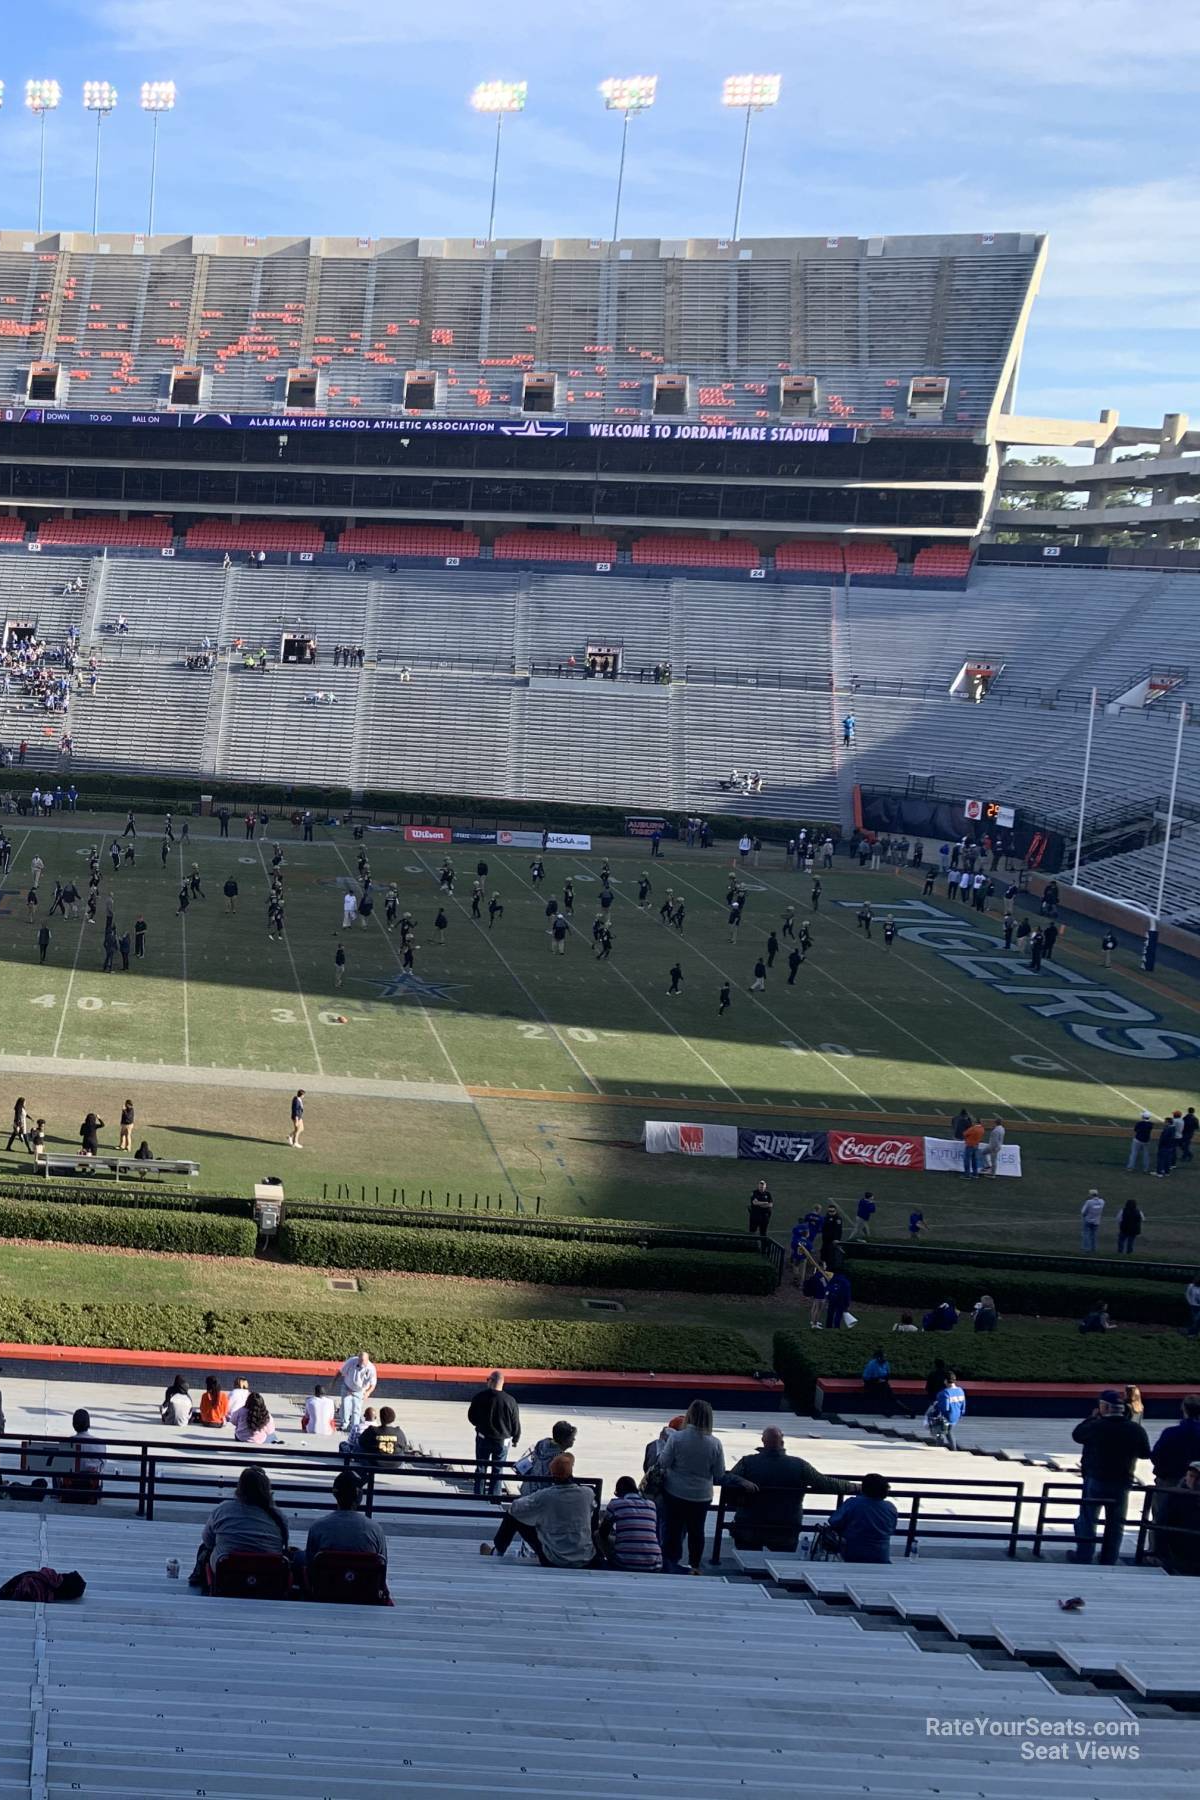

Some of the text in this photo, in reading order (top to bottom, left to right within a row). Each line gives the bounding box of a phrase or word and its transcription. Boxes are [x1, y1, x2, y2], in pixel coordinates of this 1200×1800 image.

[46, 413, 70, 421] DOWN
[90, 414, 99, 422] TO
[148, 416, 160, 424] ON
[249, 418, 495, 431] ALABAMA HIGH SCHOOL ATHLETIC ASSOCIATION
[589, 423, 830, 442] WELCOME TO JORDAN-HARE STADIUM
[628, 820, 666, 830] AUBURN
[412, 830, 445, 840] Wilson
[833, 899, 1200, 1061] TIGERS
[30, 993, 104, 1011] 40
[517, 1024, 599, 1042] 20
[1009, 1054, 1070, 1072] G
[837, 1137, 914, 1166] Coca-Cola
